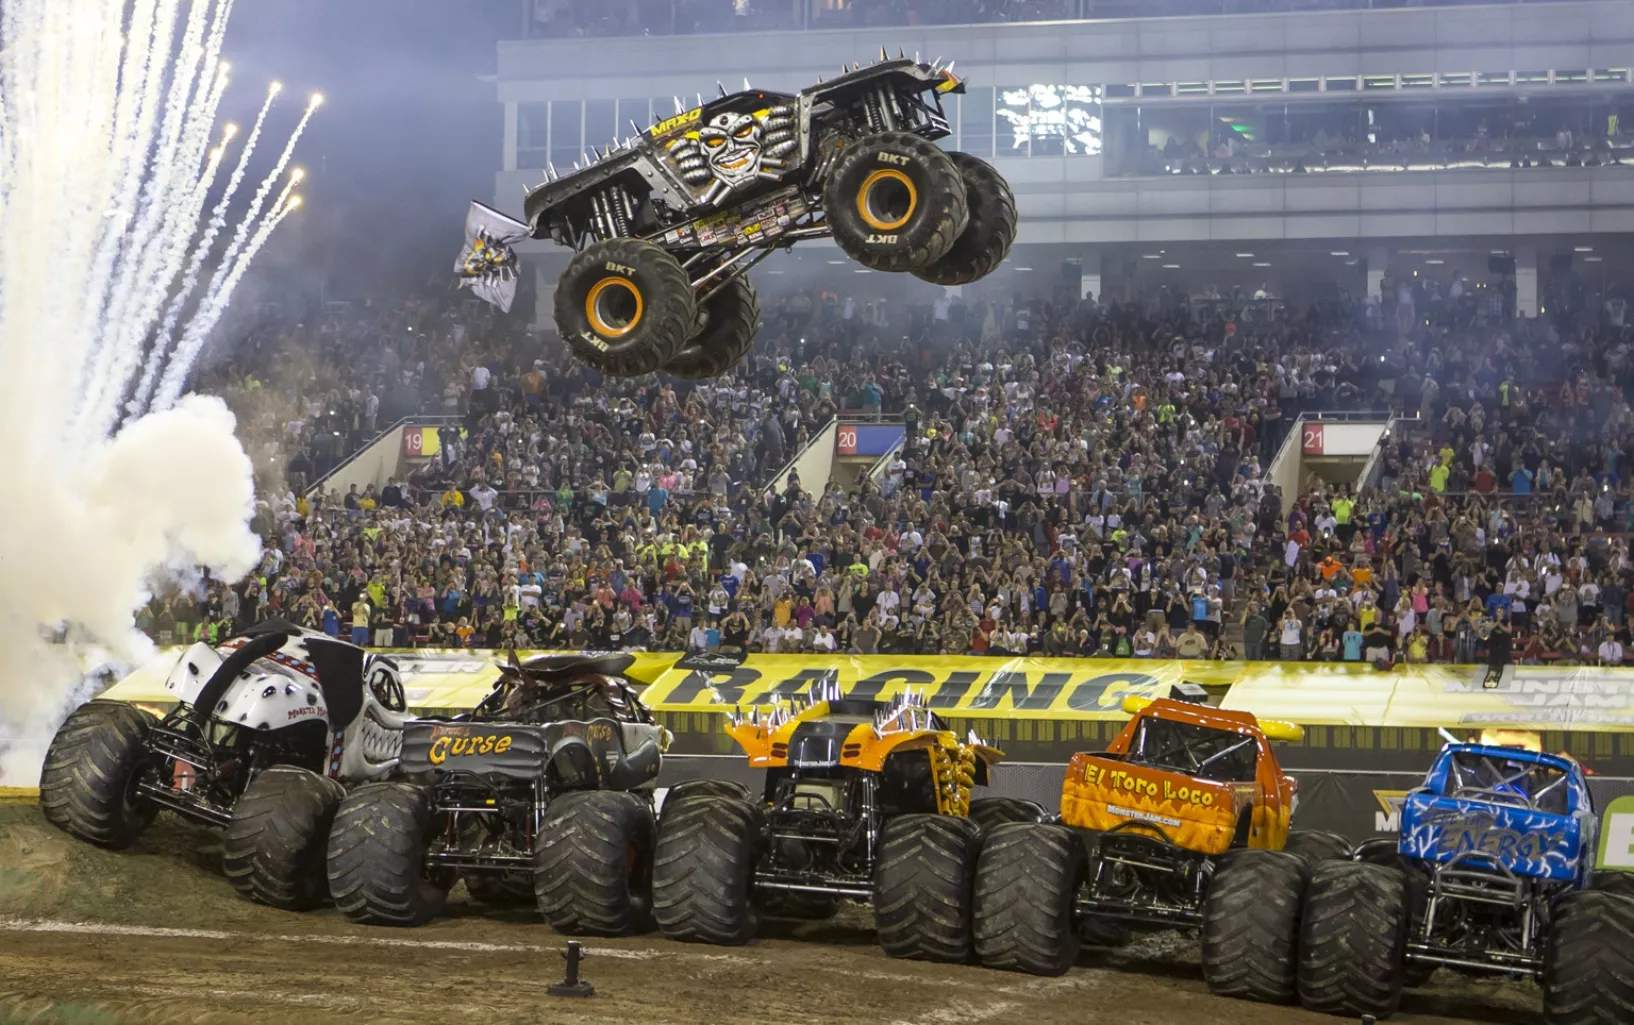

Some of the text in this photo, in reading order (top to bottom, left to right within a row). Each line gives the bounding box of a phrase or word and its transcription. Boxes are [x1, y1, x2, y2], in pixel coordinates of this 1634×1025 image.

[651, 107, 701, 137] MAX-D
[878, 151, 910, 166] BKT
[865, 234, 898, 244] BKT
[606, 261, 636, 276] BKT
[581, 331, 610, 352] BKT
[405, 433, 422, 450] 19
[838, 431, 857, 448] 20
[1304, 431, 1322, 448] 21
[663, 667, 1158, 711] RACING
[429, 735, 512, 765] Curse
[1110, 770, 1158, 796] Toro
[1164, 780, 1213, 806] Loco
